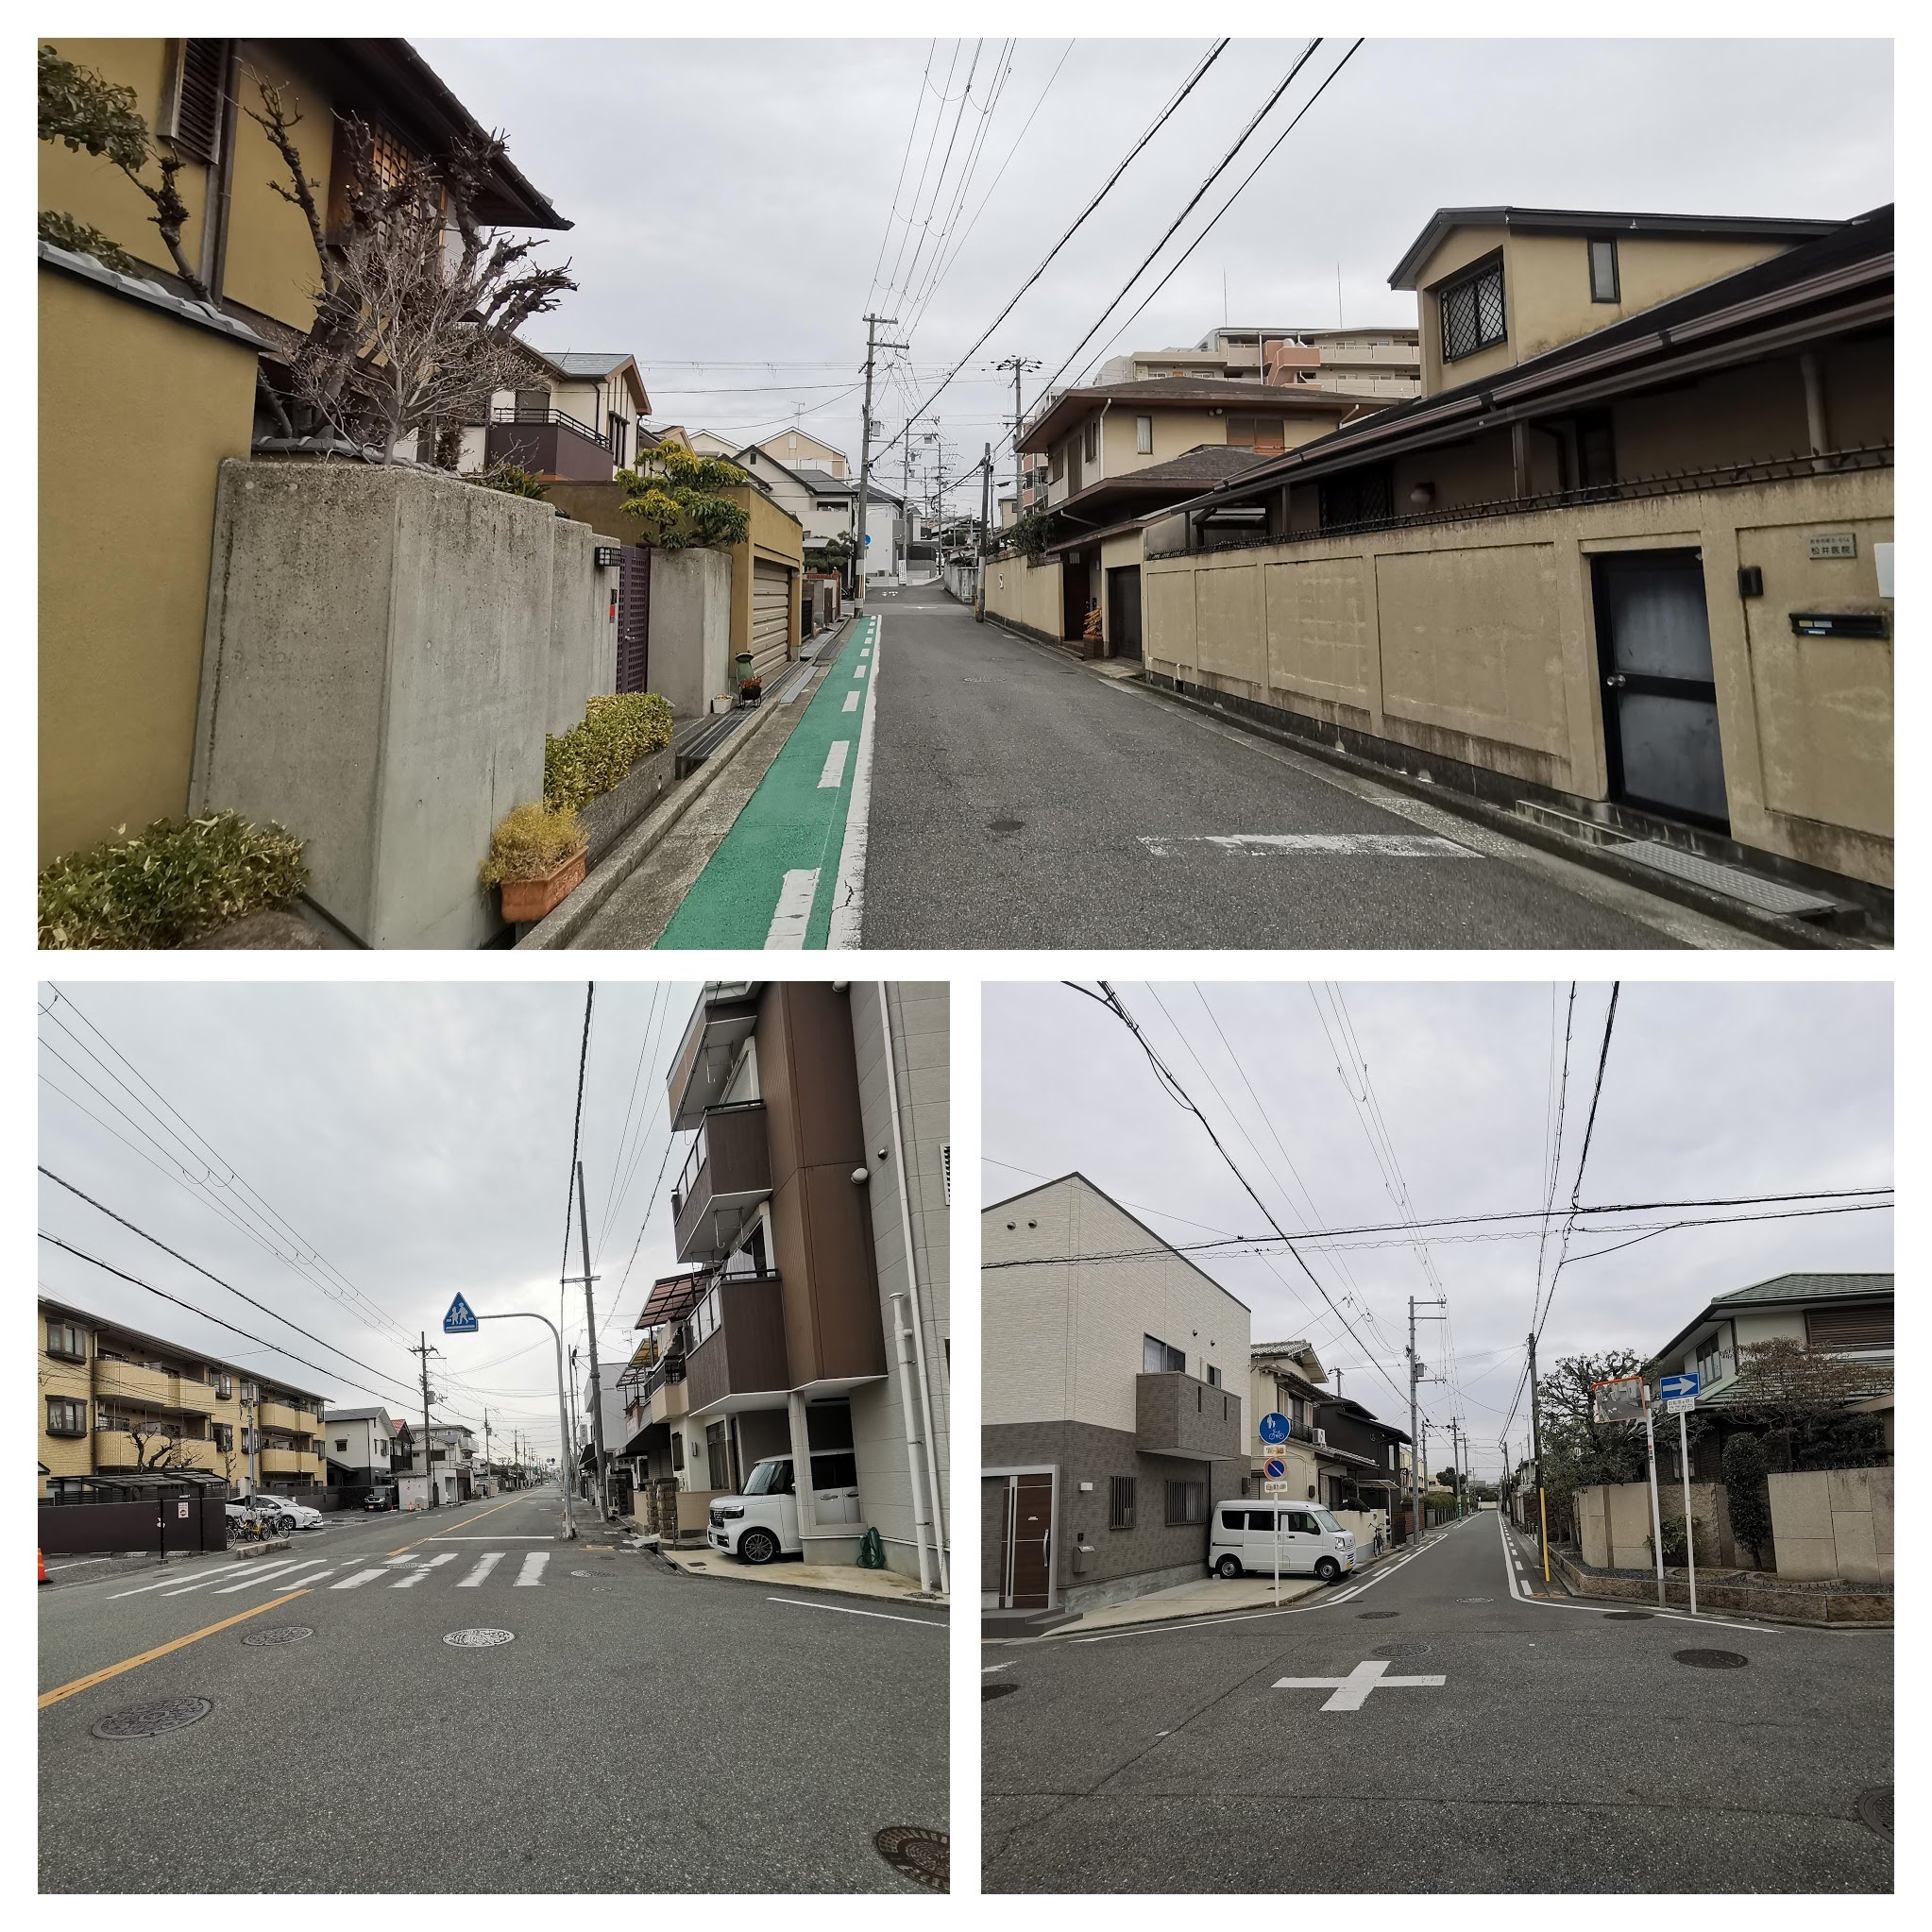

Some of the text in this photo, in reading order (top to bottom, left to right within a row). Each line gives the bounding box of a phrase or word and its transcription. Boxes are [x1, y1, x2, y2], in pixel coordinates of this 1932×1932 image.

[1811, 546, 1851, 555] 松井医院
[1669, 1403, 1694, 1413] ここから
